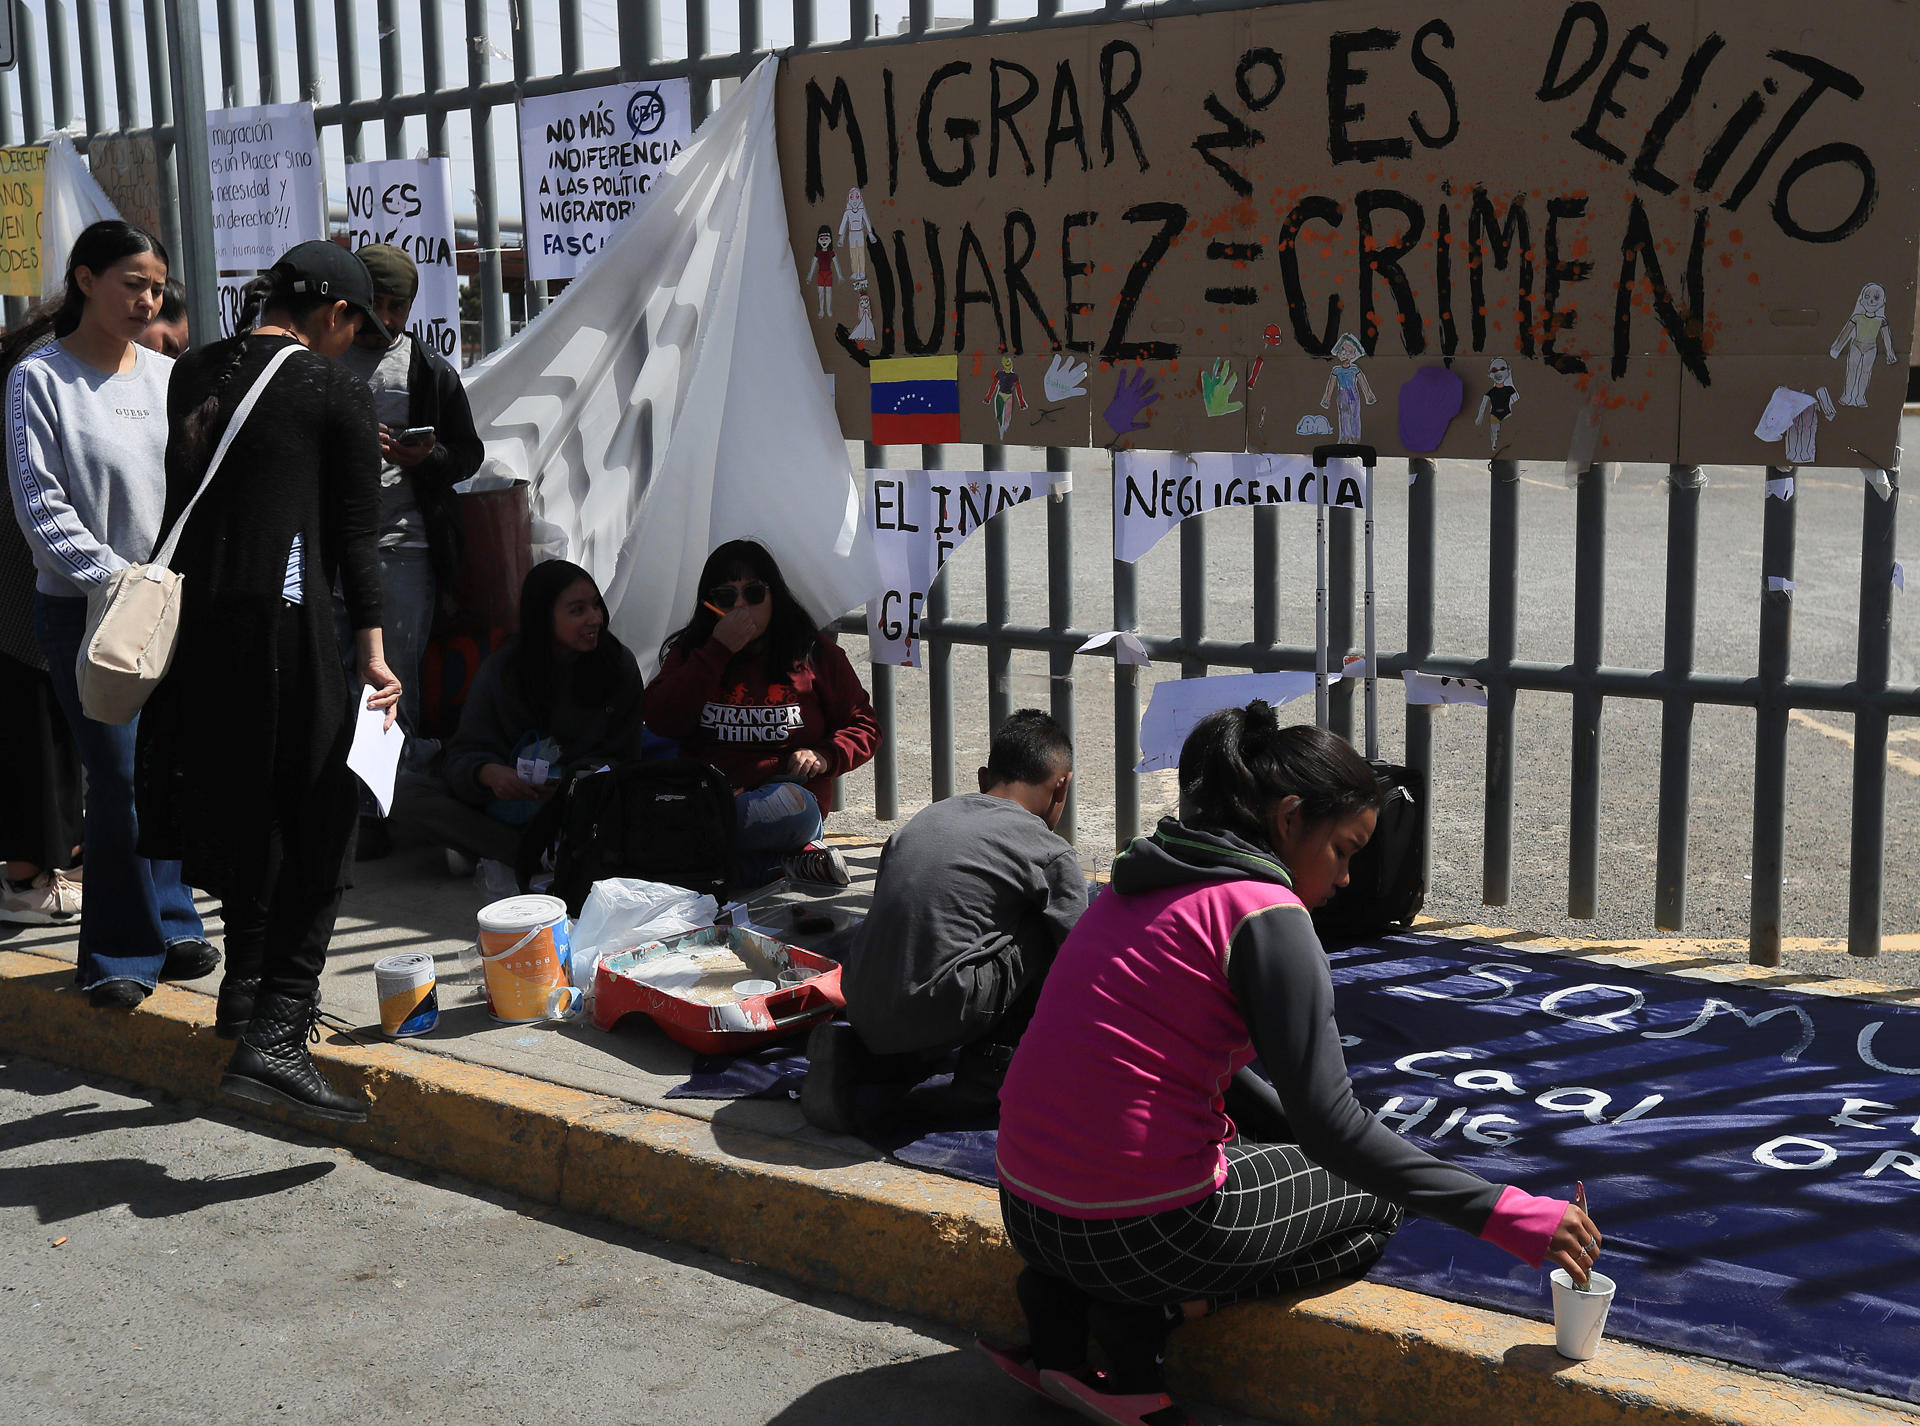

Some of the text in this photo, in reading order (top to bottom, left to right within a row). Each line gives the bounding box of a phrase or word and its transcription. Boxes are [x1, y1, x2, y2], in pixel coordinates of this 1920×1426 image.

[547, 100, 615, 143] NO MÁS
[804, 40, 1151, 206] MIGRAR
[1192, 47, 1286, 197] NO
[1326, 18, 1459, 166] ES
[212, 118, 273, 155] migración
[1, 149, 47, 174] DERECH
[548, 139, 682, 172] INDIFERENCIA
[217, 177, 270, 202] necesidad
[539, 169, 652, 197] A LAS POLÍTIC
[347, 183, 422, 219] NO ES
[539, 200, 636, 224] MIGRATOR
[0, 245, 39, 273] ODES
[835, 201, 1190, 368] JUAREZ
[13, 382, 22, 420] GUESS
[115, 408, 150, 417] GUESS
[16, 425, 26, 463] GUESS
[22, 468, 39, 504] GUESS
[874, 480, 919, 533] EL
[35, 508, 61, 540] GUESS
[59, 542, 91, 570] GUESS
[700, 702, 804, 727] STRANGER
[715, 724, 790, 742] THINGS
